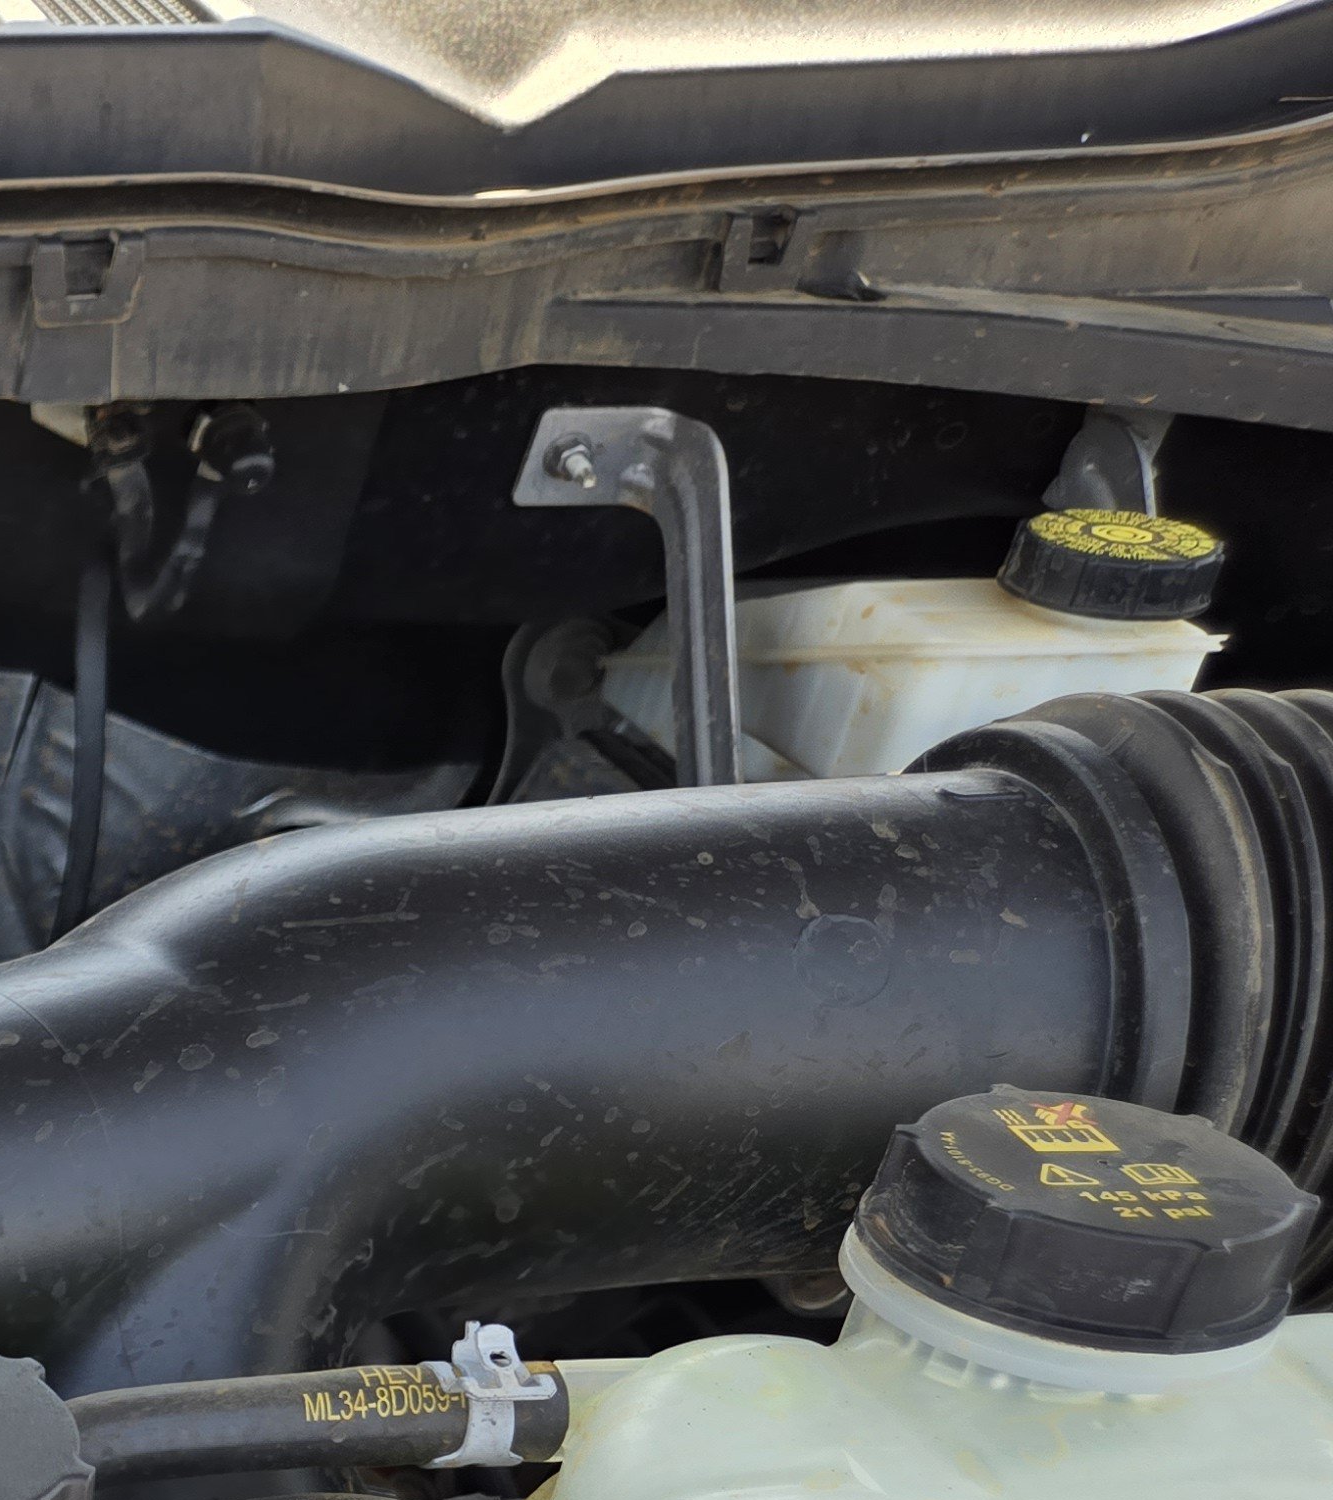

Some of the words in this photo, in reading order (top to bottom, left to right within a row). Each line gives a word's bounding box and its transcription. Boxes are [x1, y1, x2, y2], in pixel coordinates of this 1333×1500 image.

[1079, 1190, 1139, 1202] 145
[1141, 1189, 1208, 1201] kPa
[1112, 1206, 1154, 1218] 21
[1162, 1205, 1213, 1220] psi
[358, 1367, 422, 1387] HEV
